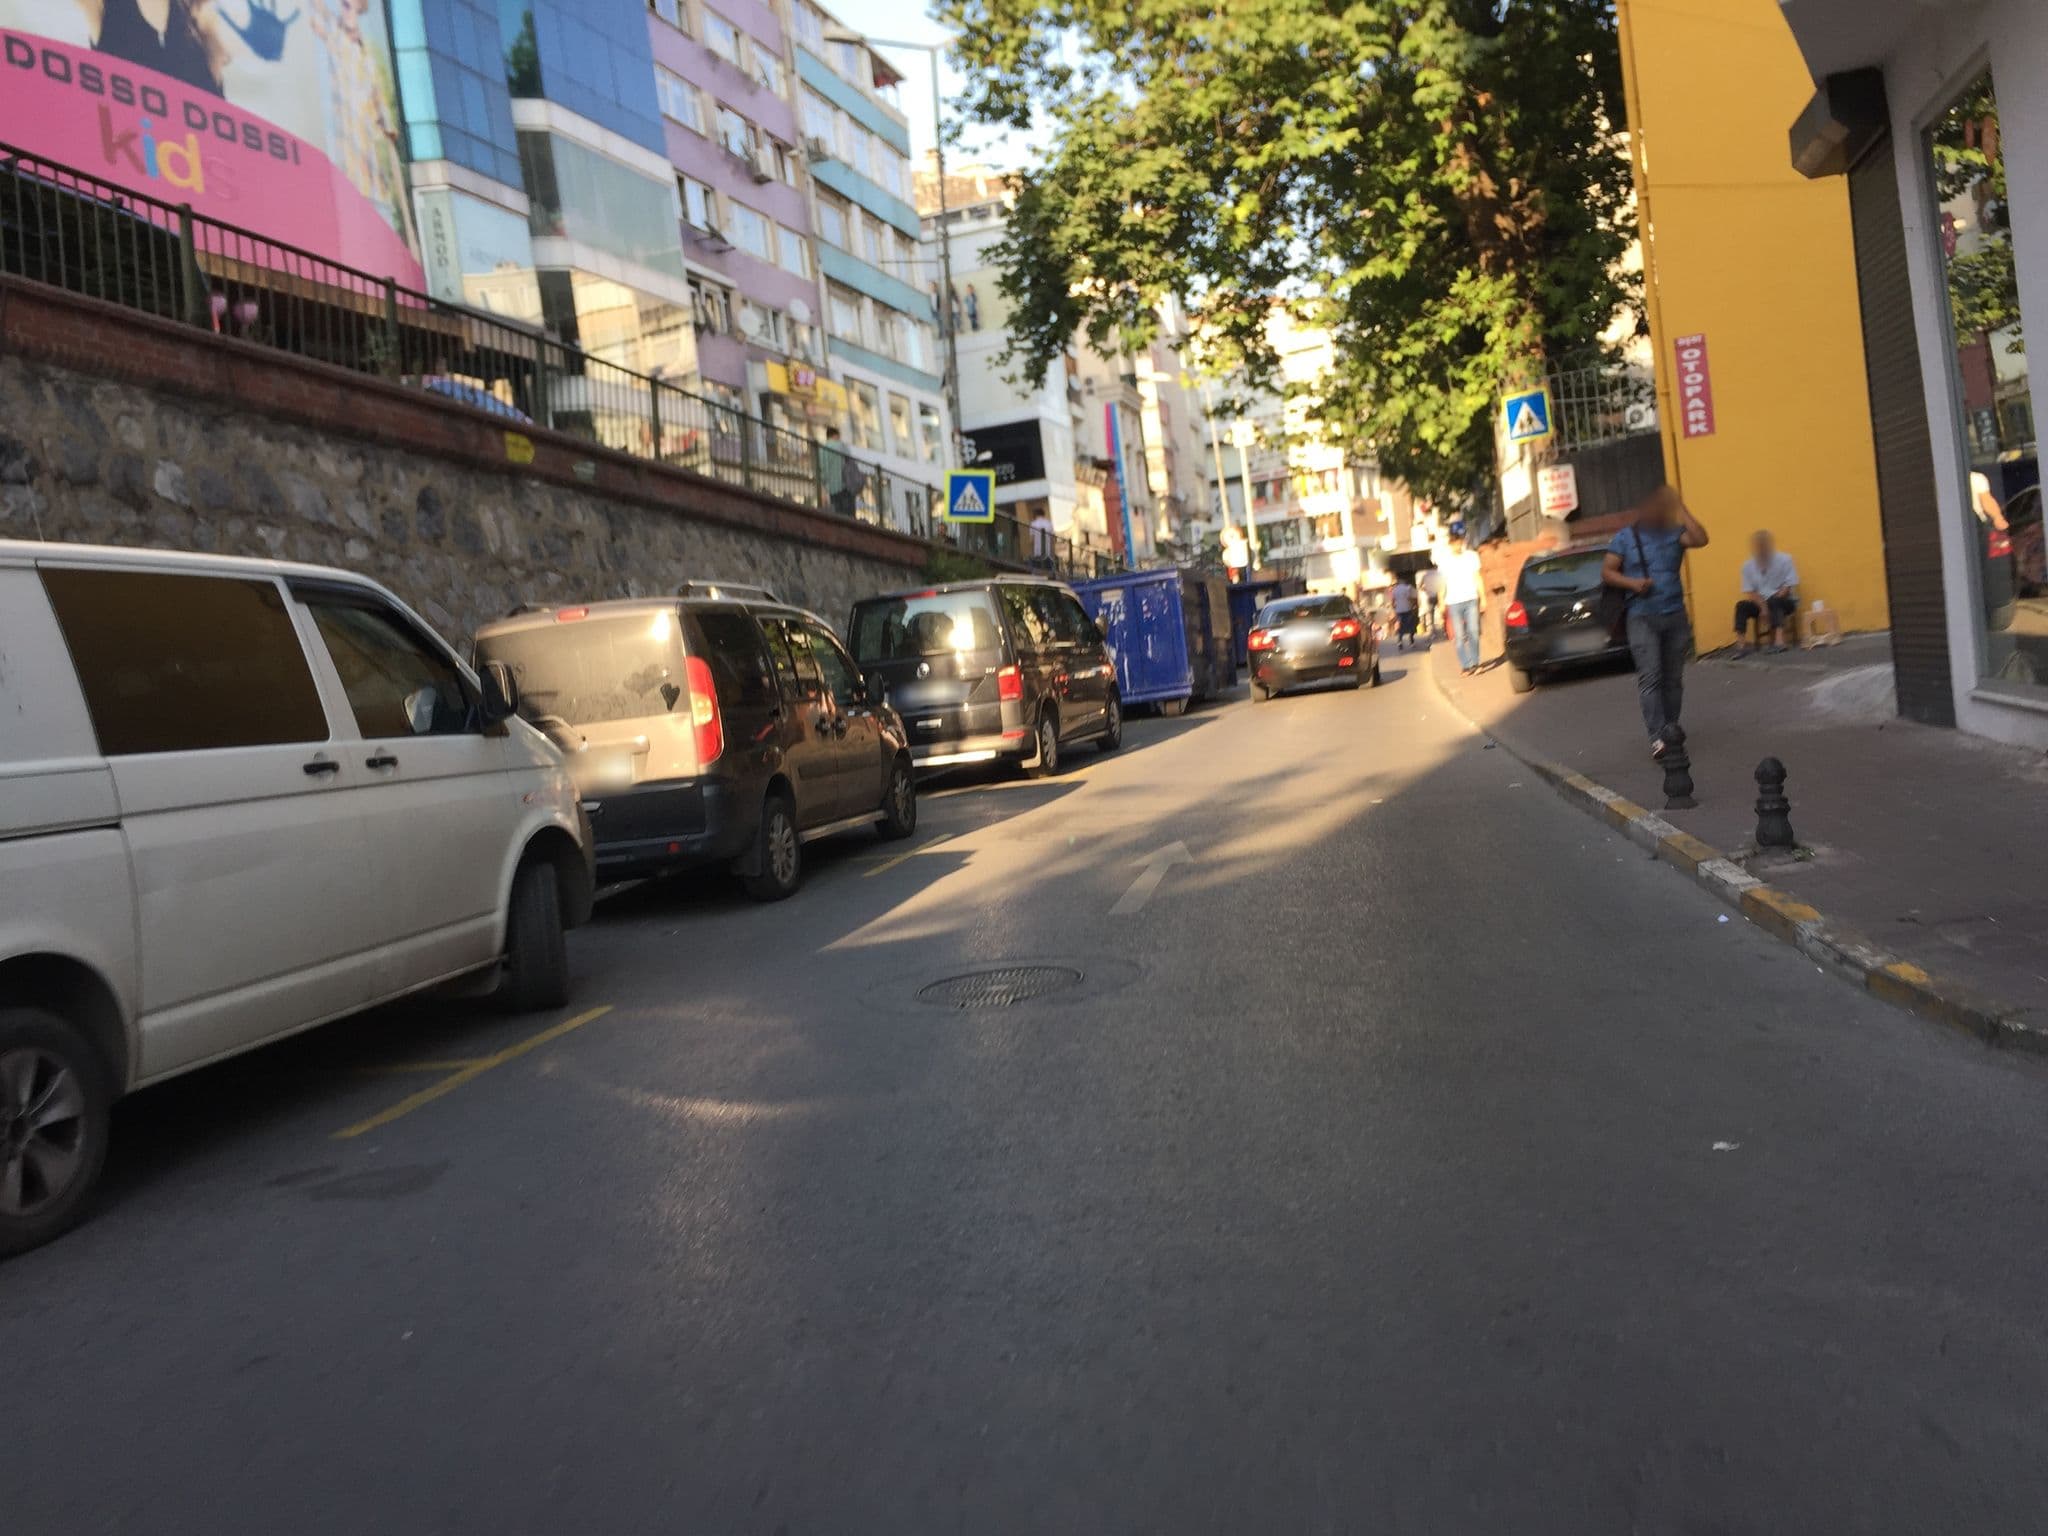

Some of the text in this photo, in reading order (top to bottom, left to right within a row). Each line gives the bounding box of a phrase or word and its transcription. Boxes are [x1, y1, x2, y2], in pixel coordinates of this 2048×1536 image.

[4, 34, 301, 166] DOSSO DOSSI
[1681, 348, 1708, 435] OTOPARK
